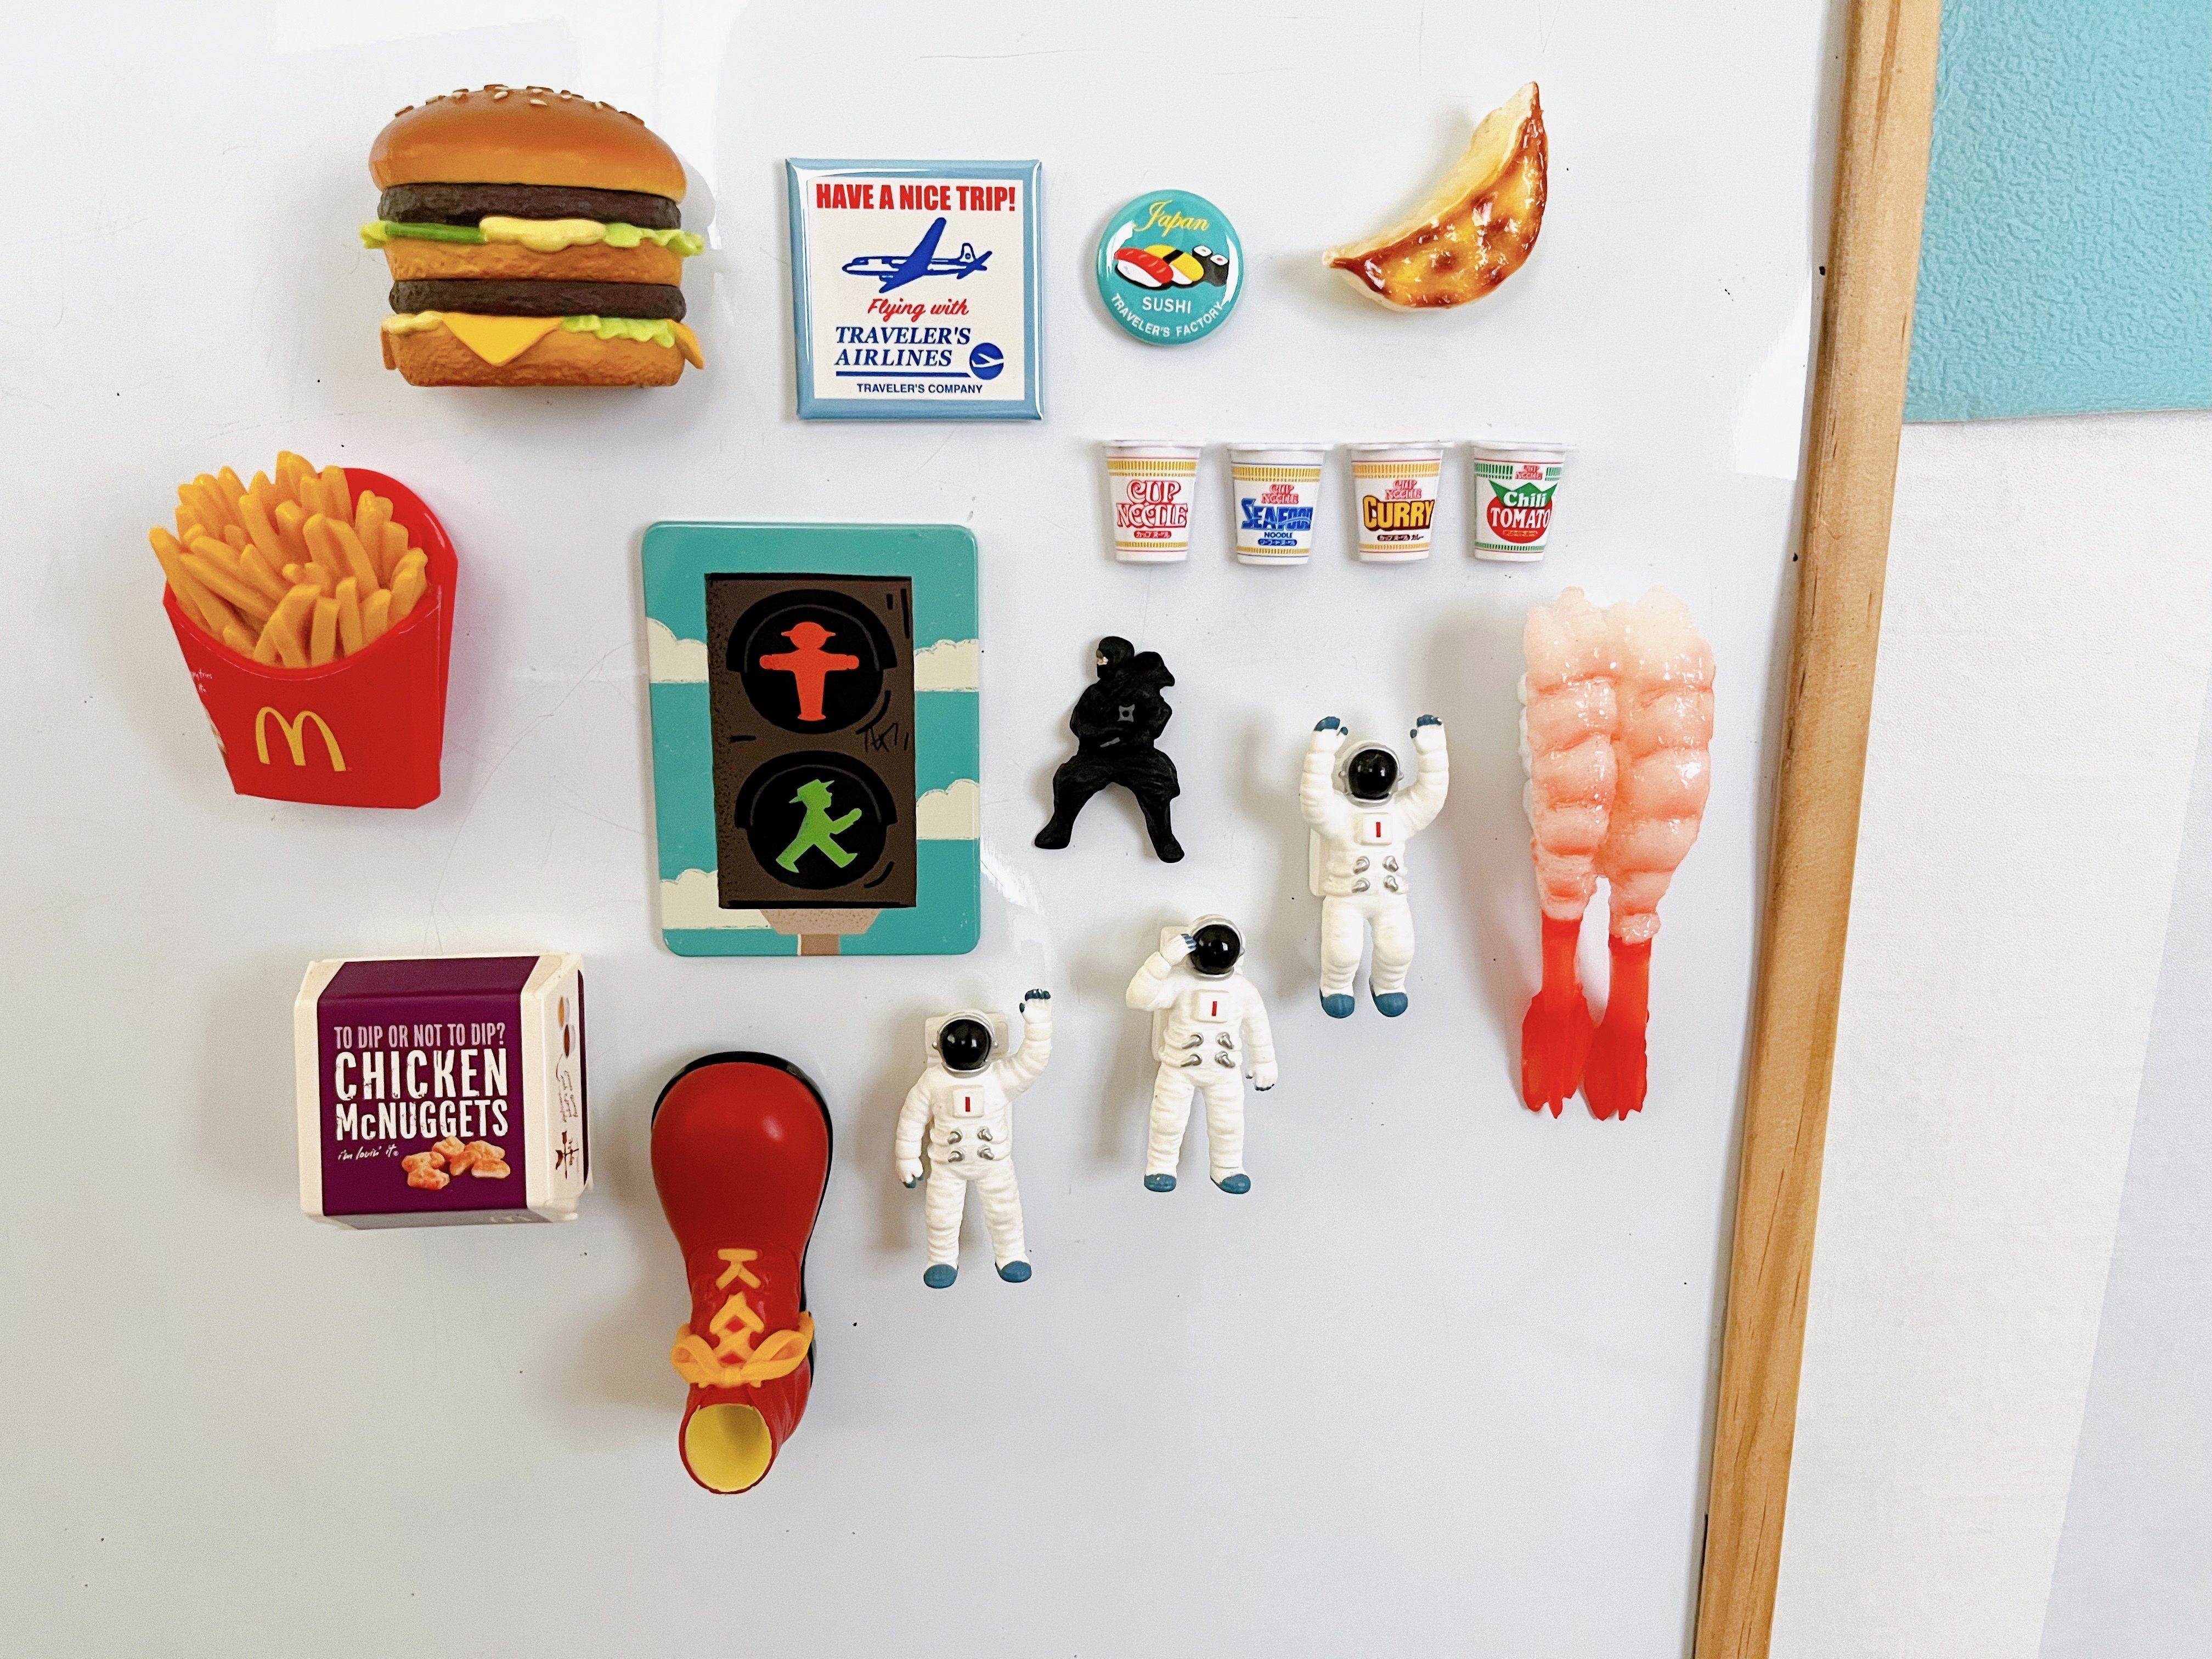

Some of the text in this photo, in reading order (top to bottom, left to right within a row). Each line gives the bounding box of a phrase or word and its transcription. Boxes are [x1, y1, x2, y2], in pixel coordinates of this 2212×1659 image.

[816, 184, 1015, 211] HAVE A NICE TRIP!
[1132, 200, 1210, 237] Japan
[867, 298, 969, 322] Flying with
[1111, 293, 1223, 337] TRAVELER'S FACTORY
[1142, 296, 1191, 314] SUSHI
[836, 326, 970, 345] TRAVELER'S
[834, 349, 952, 366] AIRLINES
[857, 383, 983, 394] TRAVELER'S COMPANY
[1127, 479, 1181, 504] CUP
[1504, 492, 1547, 507] Chili
[1241, 498, 1313, 531] SEAFOOD
[1363, 495, 1435, 531] CURRY
[1491, 507, 1550, 528] TOMATO
[334, 1022, 505, 1049] TO DIP OR NOT TO DIP?
[335, 1048, 507, 1101] CHICKEN
[336, 1099, 508, 1141] McNUGGETS
